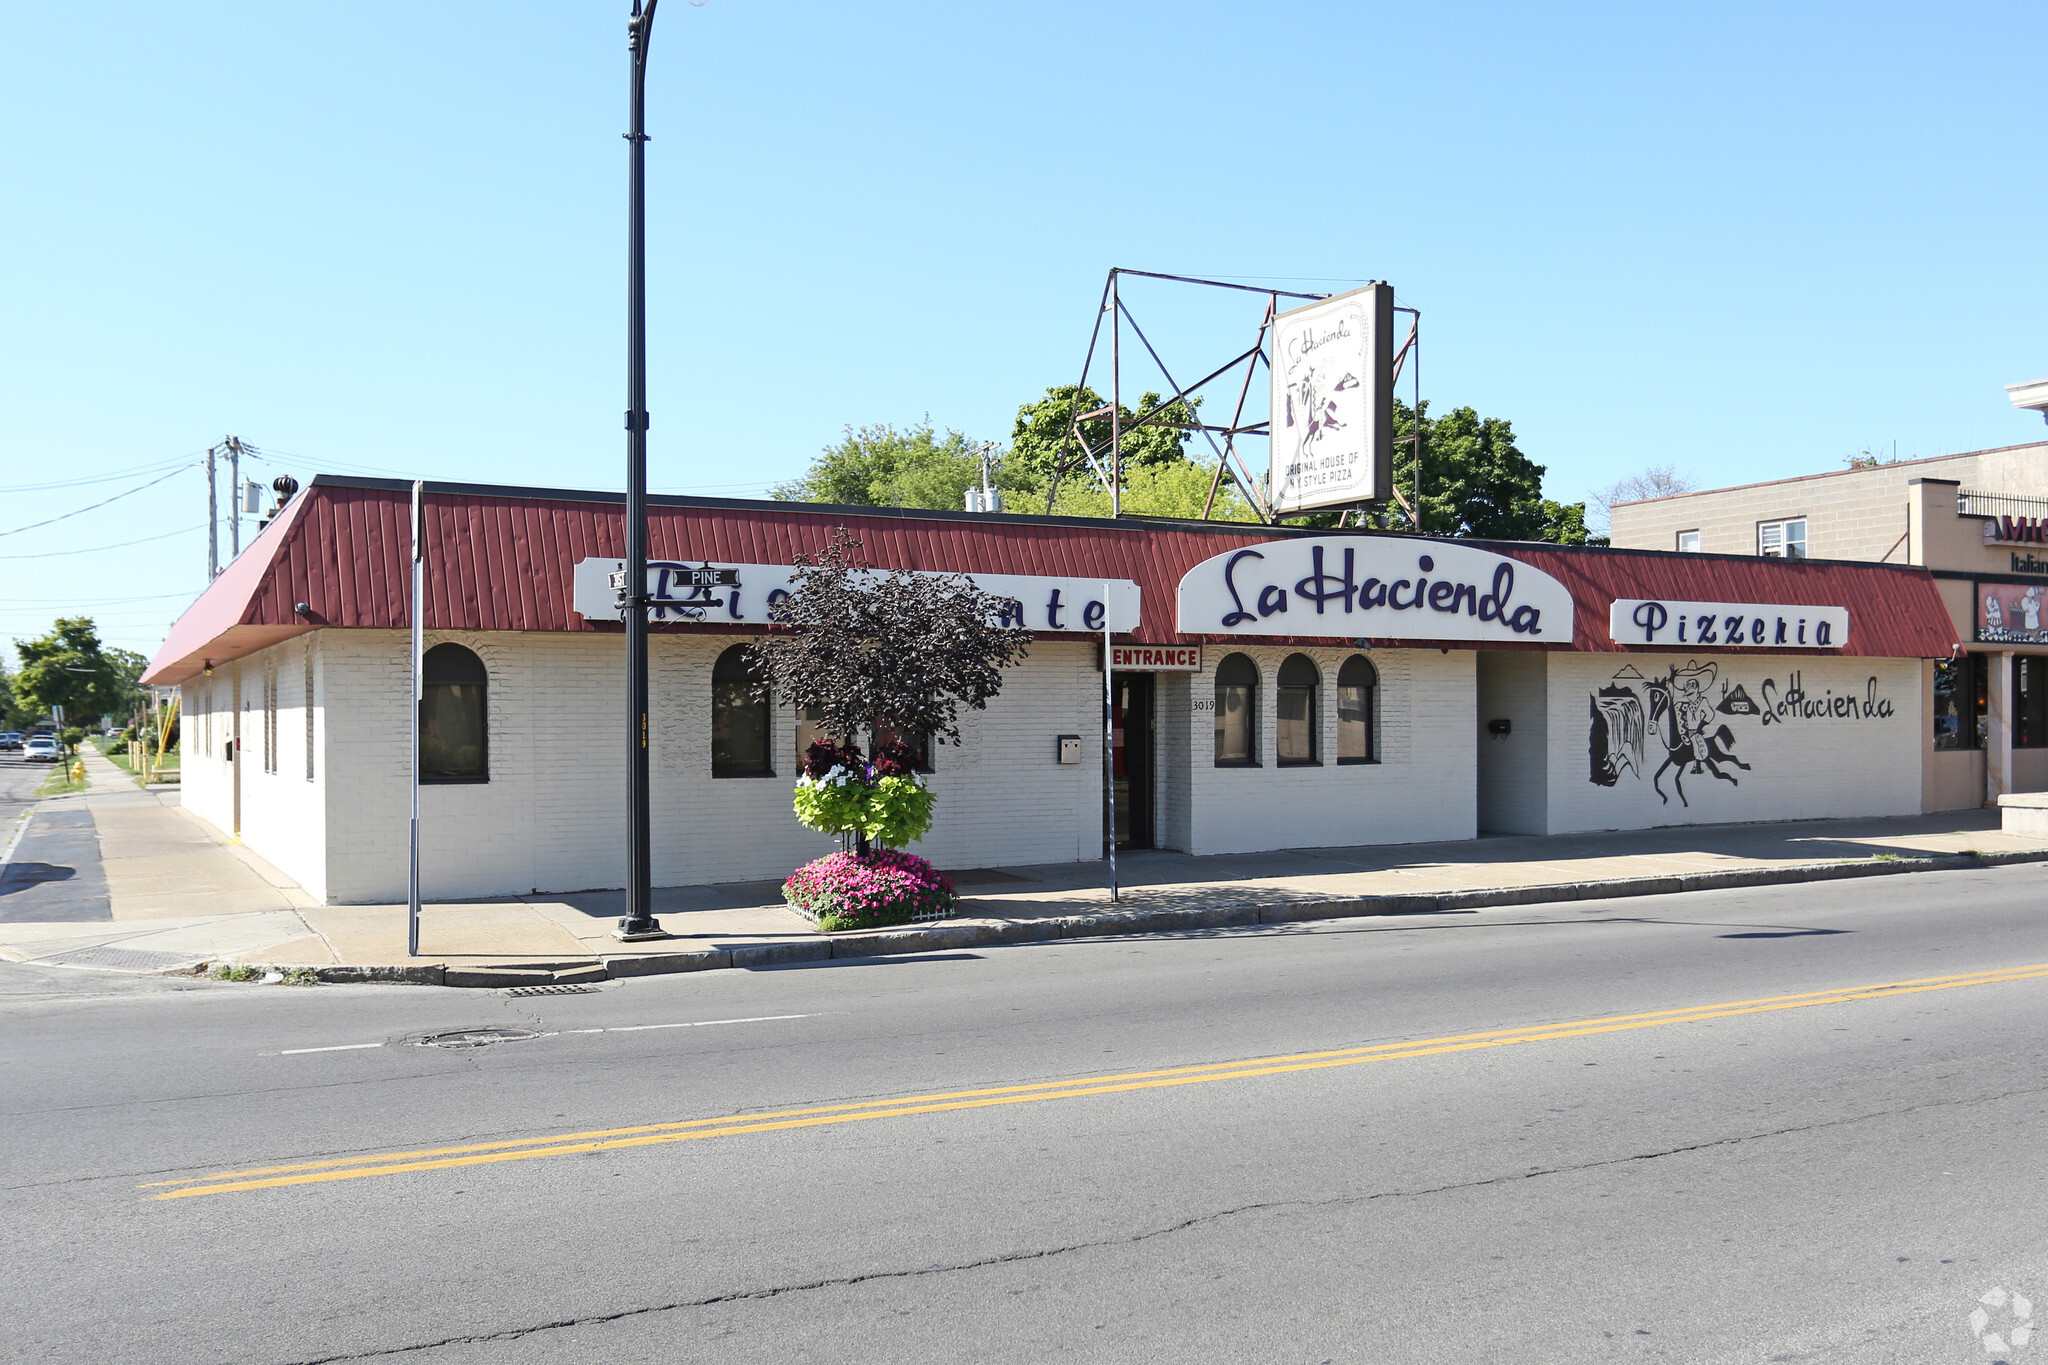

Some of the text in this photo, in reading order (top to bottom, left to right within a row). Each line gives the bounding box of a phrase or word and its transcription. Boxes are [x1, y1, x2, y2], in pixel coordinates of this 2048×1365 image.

[1288, 319, 1351, 375] La Hacienda
[1285, 452, 1359, 477] ORIGINAL HOUSE OF
[1303, 472, 1327, 487] STYLE
[1329, 468, 1353, 483] PIZZA
[692, 571, 721, 585] PINE
[1221, 545, 1543, 635] La Hacienda
[1632, 601, 1832, 646] Pizzeria
[1113, 649, 1197, 666] ENTRANCE
[1193, 700, 1215, 711] 3019
[1761, 669, 1895, 726] La Hacienda
